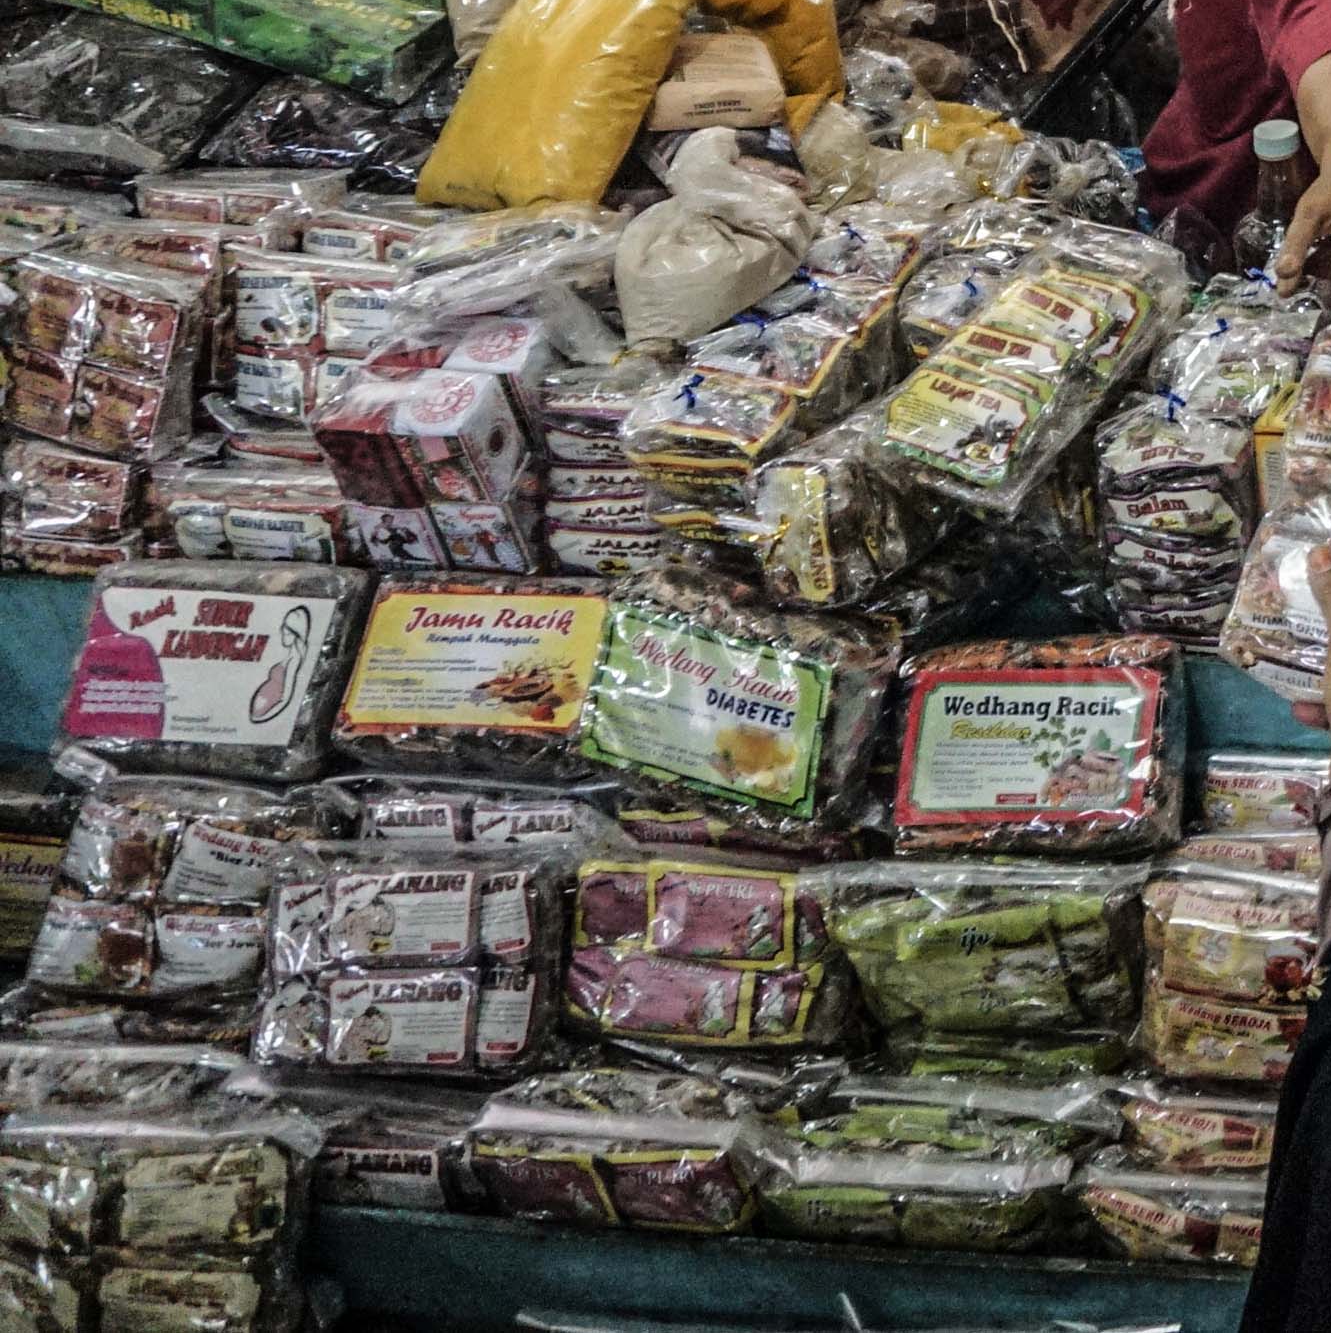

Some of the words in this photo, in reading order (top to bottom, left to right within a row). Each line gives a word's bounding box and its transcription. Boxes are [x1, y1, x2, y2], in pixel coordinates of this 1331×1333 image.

[1126, 495, 1188, 516] Salam
[405, 606, 482, 633] Jamu
[492, 608, 576, 636] Racik
[632, 631, 717, 685] Wedang
[705, 687, 796, 728] DIABETES
[943, 695, 1051, 722] Wedhang
[1222, 1012, 1272, 1032] SEROJA
